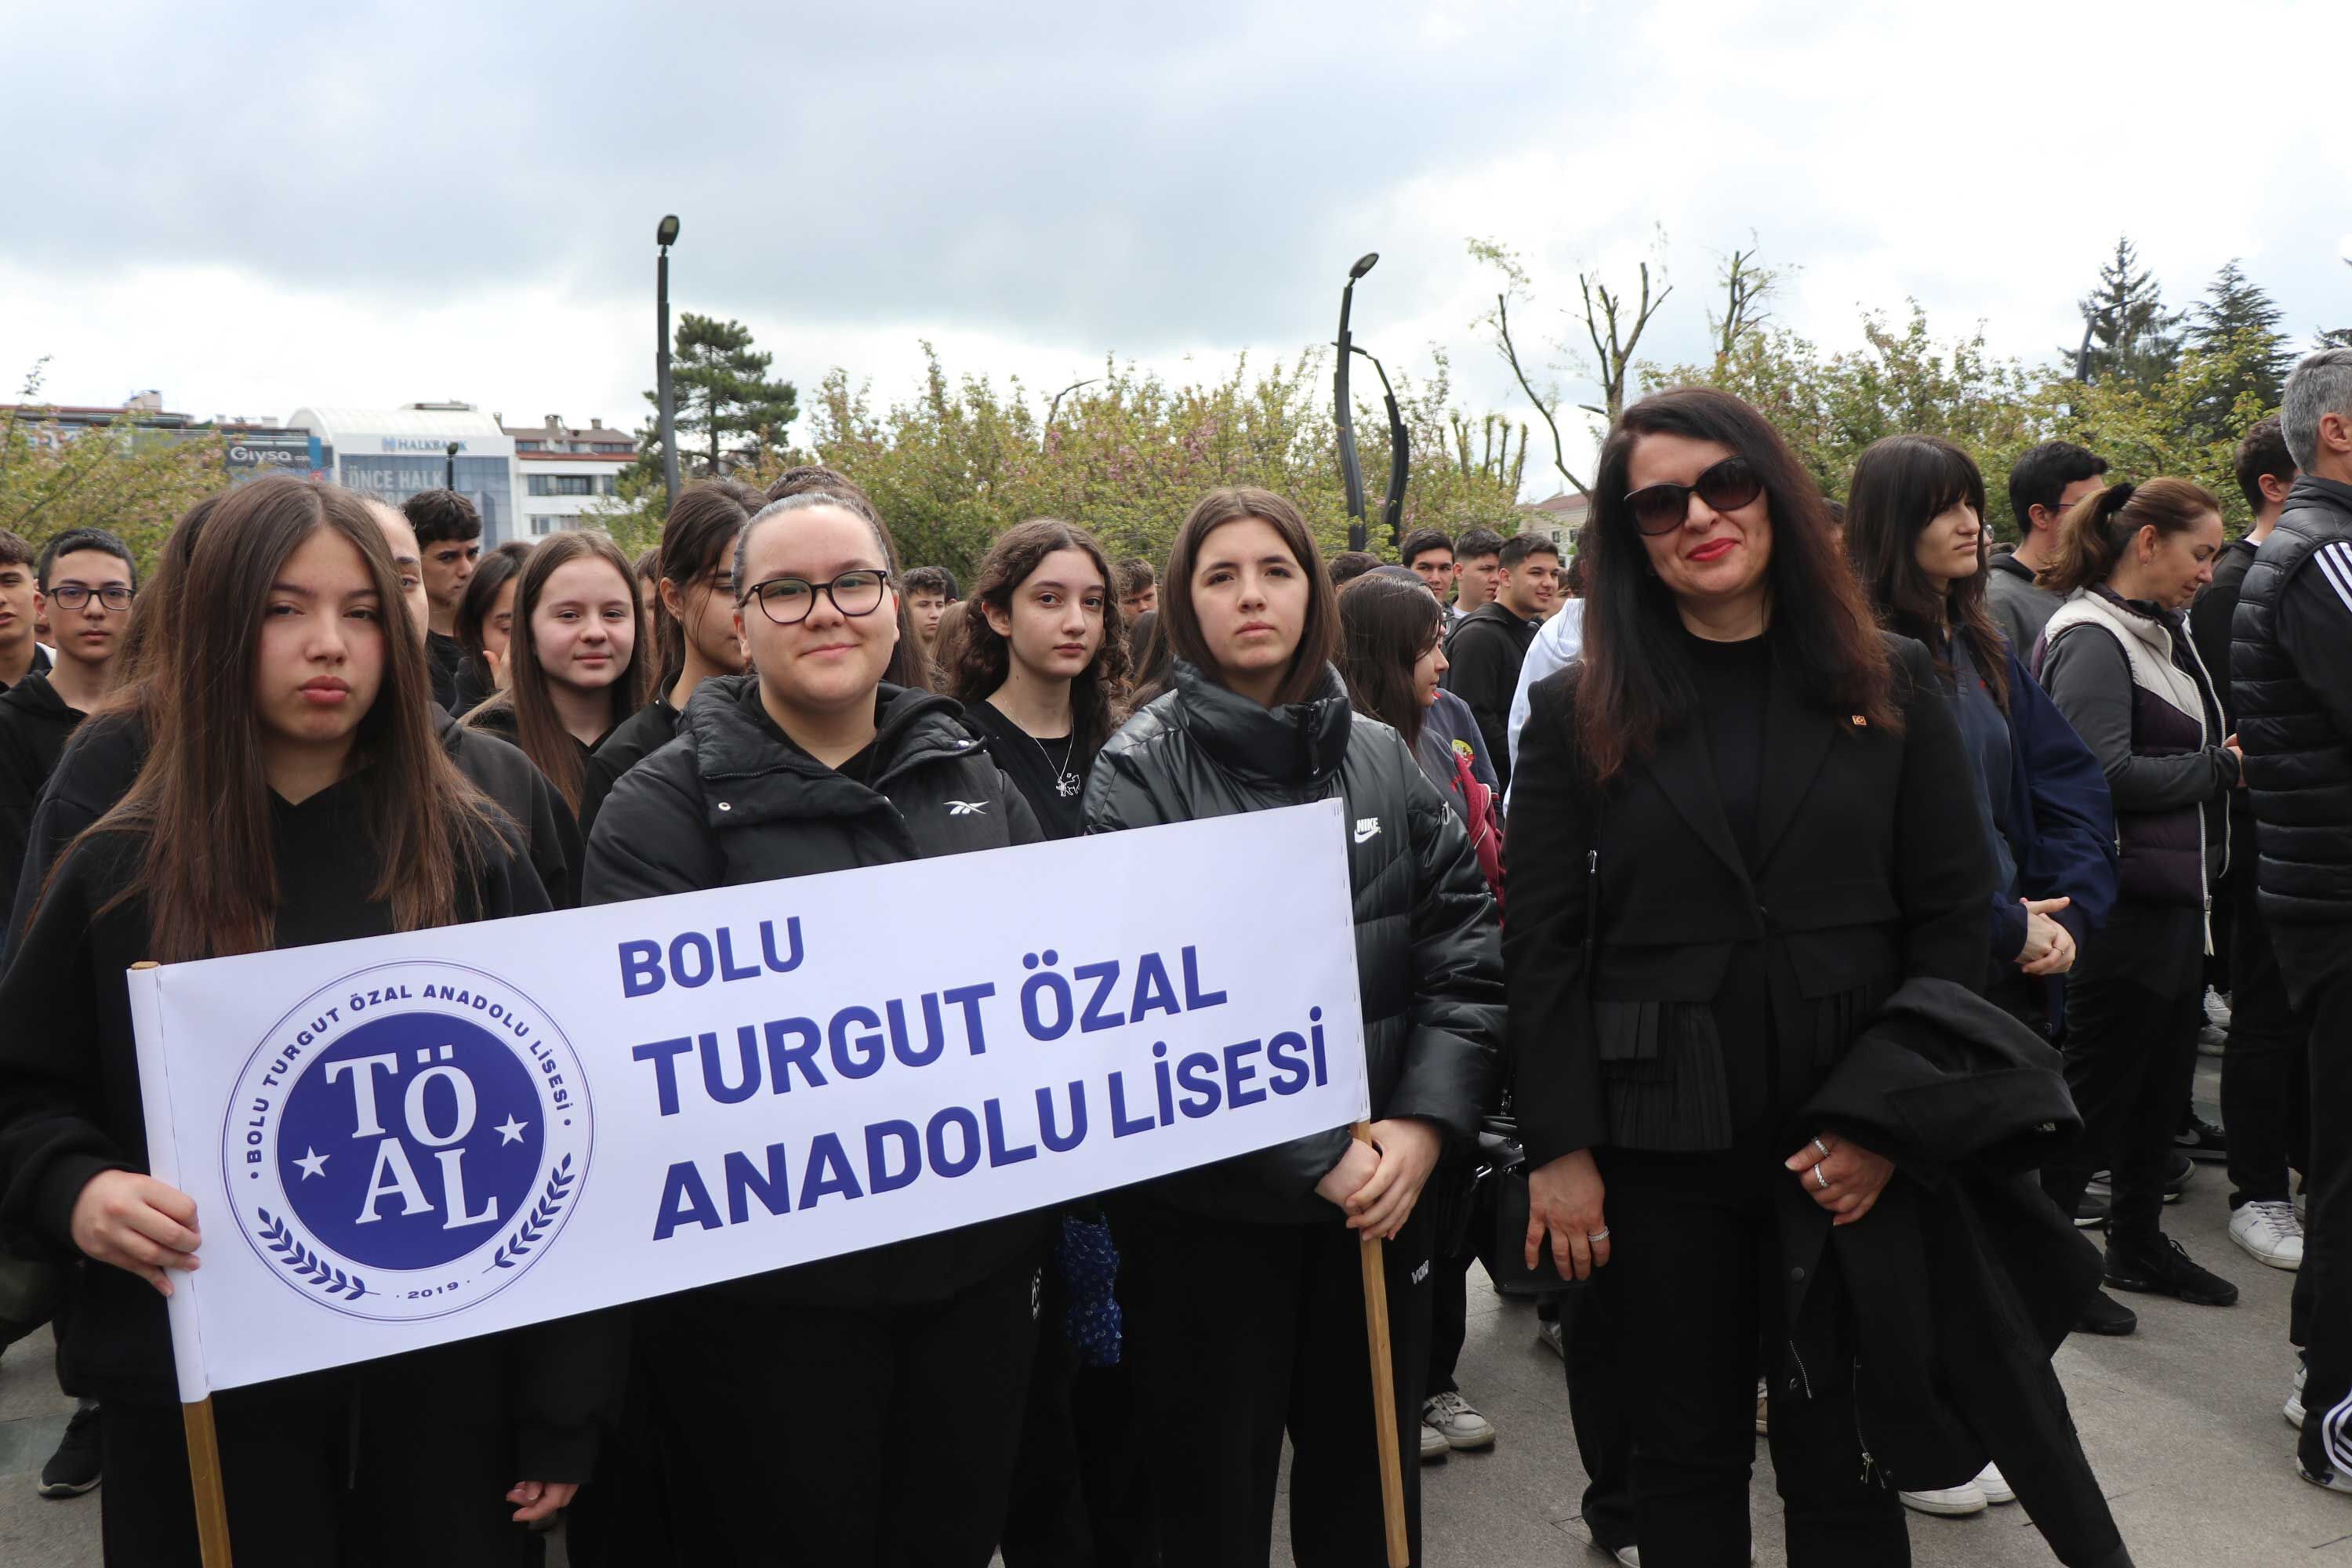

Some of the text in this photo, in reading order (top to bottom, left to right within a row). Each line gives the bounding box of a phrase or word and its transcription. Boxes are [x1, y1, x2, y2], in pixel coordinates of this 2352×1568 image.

[397, 438, 468, 452] HALKBAK
[349, 465, 443, 489] ÖNCE HALK
[1356, 817, 1378, 833] NIKE
[618, 915, 805, 999] BOLU
[631, 945, 1229, 1117] TURGUT ÖZAL
[246, 984, 574, 1164] BOLU TURGUT ÖZAL ANADOLU LİSESİ
[652, 1005, 1328, 1242] ANADOLU LİSESİ
[407, 1281, 459, 1300] 2019
